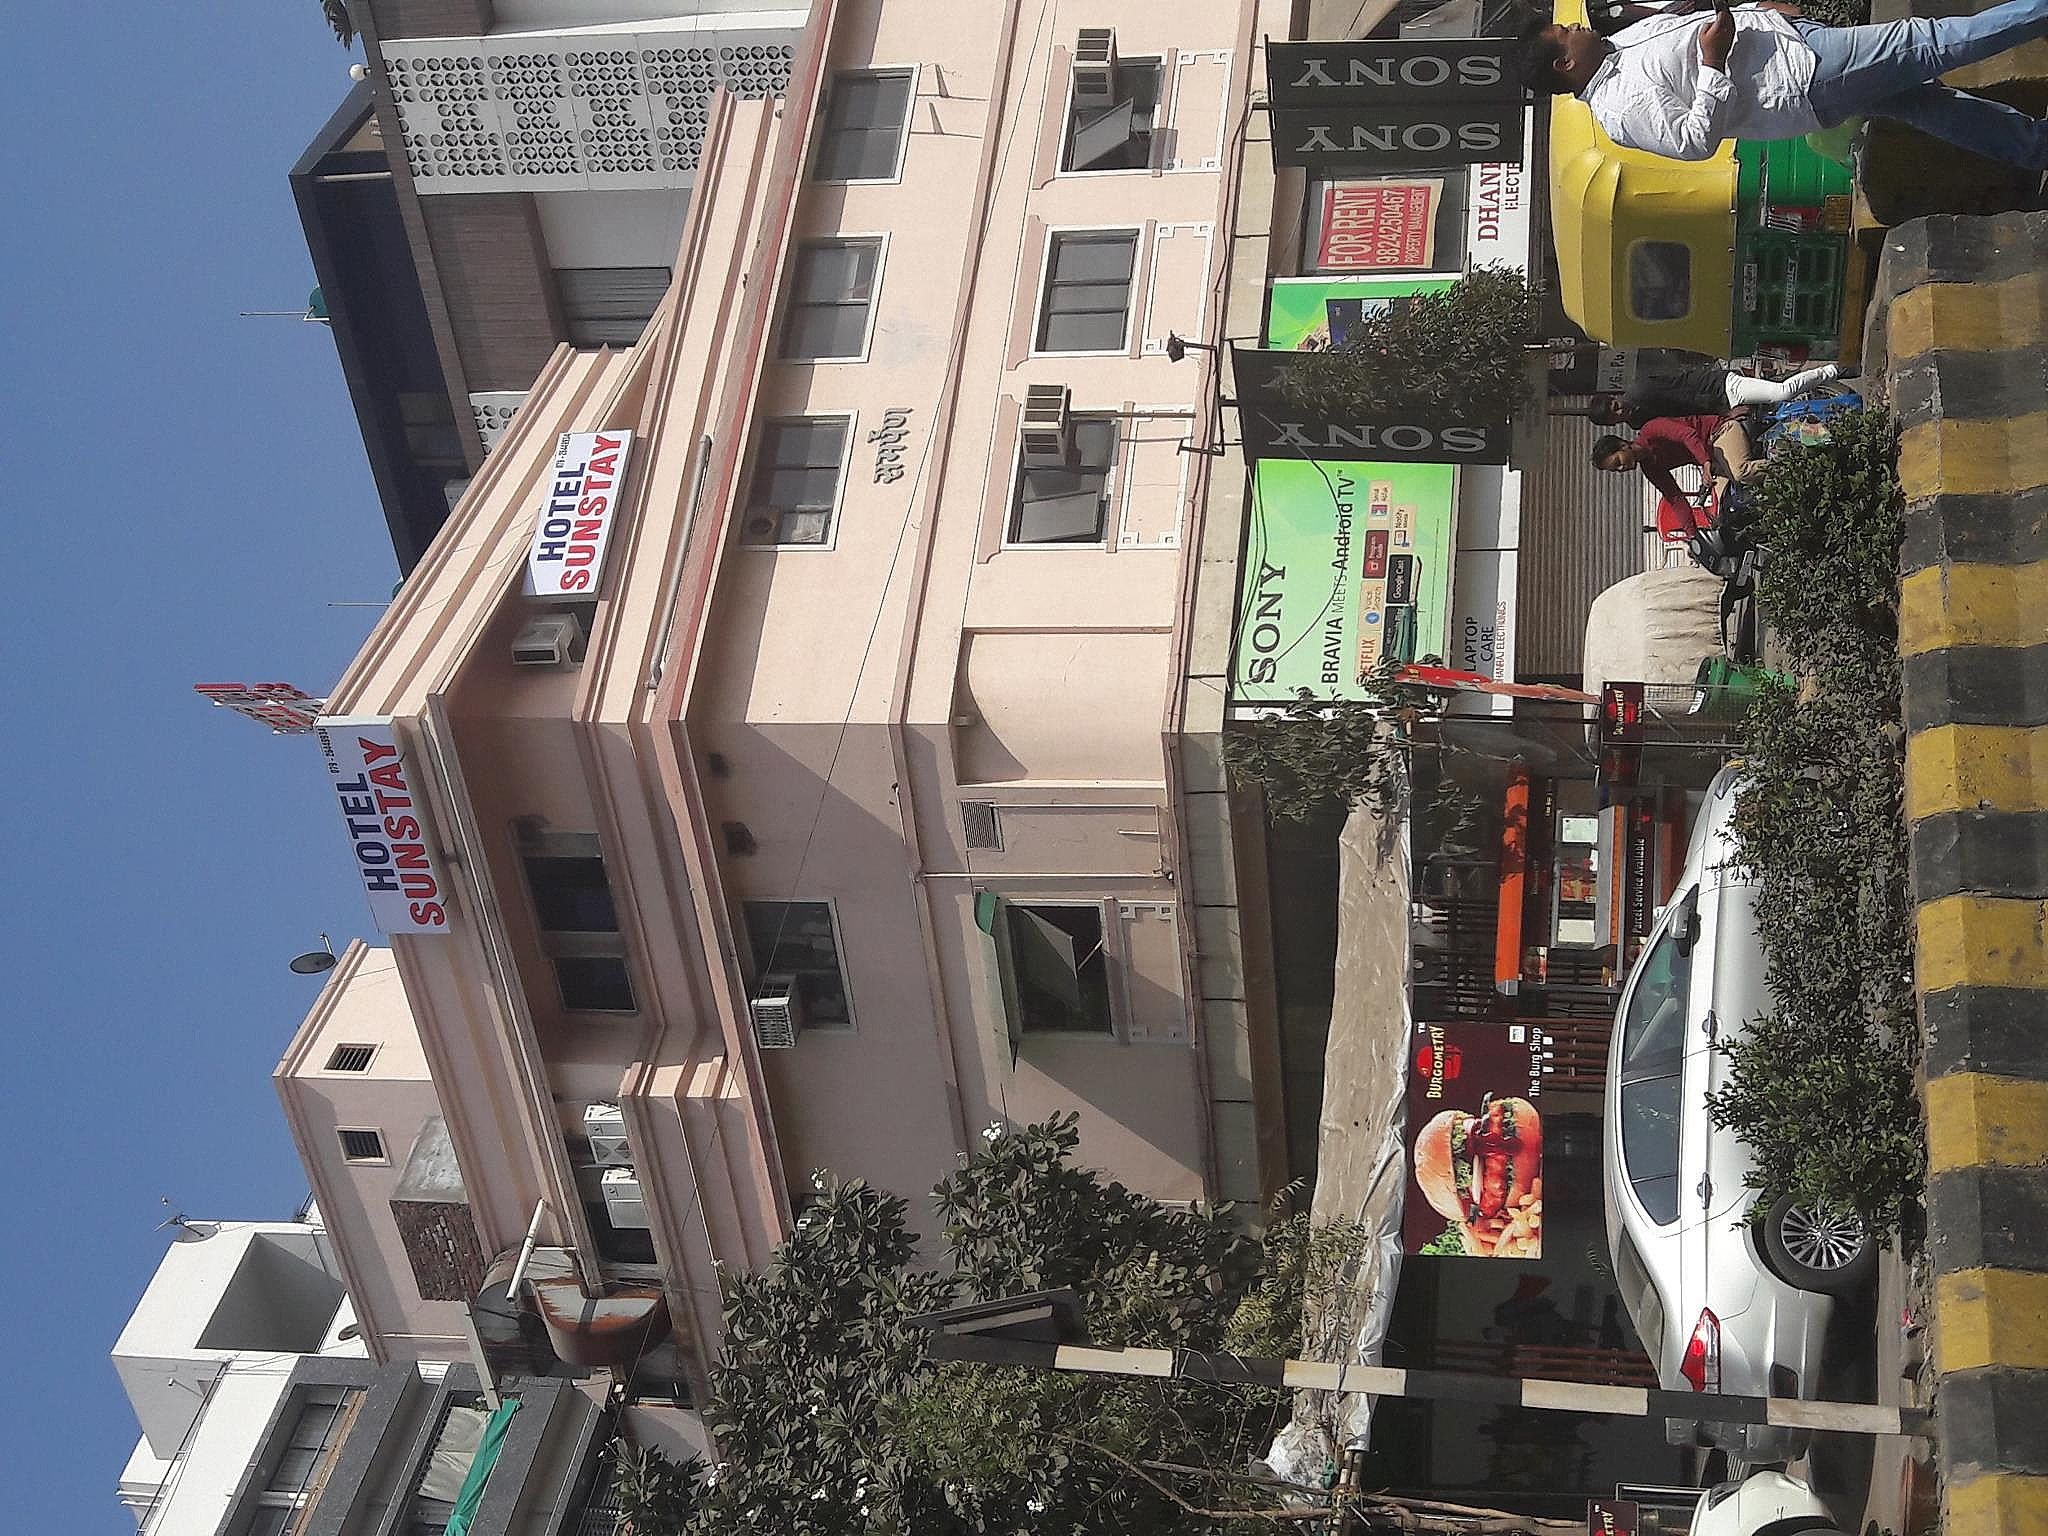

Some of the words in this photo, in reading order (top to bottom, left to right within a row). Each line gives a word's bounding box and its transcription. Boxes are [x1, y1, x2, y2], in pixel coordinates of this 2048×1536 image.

[1290, 56, 1500, 86] SONY
[1296, 122, 1500, 151] SONY
[1331, 190, 1377, 230] RENT
[1376, 190, 1405, 264] 9824250467
[1406, 188, 1425, 230] MANAGEMENT
[1328, 232, 1373, 264] FOR
[1404, 230, 1420, 263] PROPERTY
[1268, 424, 1486, 452] SONY
[536, 462, 586, 562] HOTEL
[560, 434, 622, 590] SUNSTAY
[1332, 504, 1353, 570] Android
[1331, 576, 1348, 613] MEETS
[1392, 575, 1404, 599] Google
[1248, 561, 1286, 684] SONY
[1321, 617, 1344, 684] BRAVIA
[1464, 616, 1478, 672] LAPTOP
[1480, 626, 1494, 662] CARE
[336, 773, 400, 891] HOTEL
[358, 736, 445, 926] SUNSTAY
[1633, 838, 1645, 876] Available
[1632, 878, 1644, 907] Service
[1631, 909, 1643, 934] Parcel
[1529, 1028, 1543, 1052] Shop
[1426, 1026, 1444, 1098] BURGOMETRY
[1528, 1054, 1542, 1076] Burg
[1528, 1080, 1540, 1096] The
